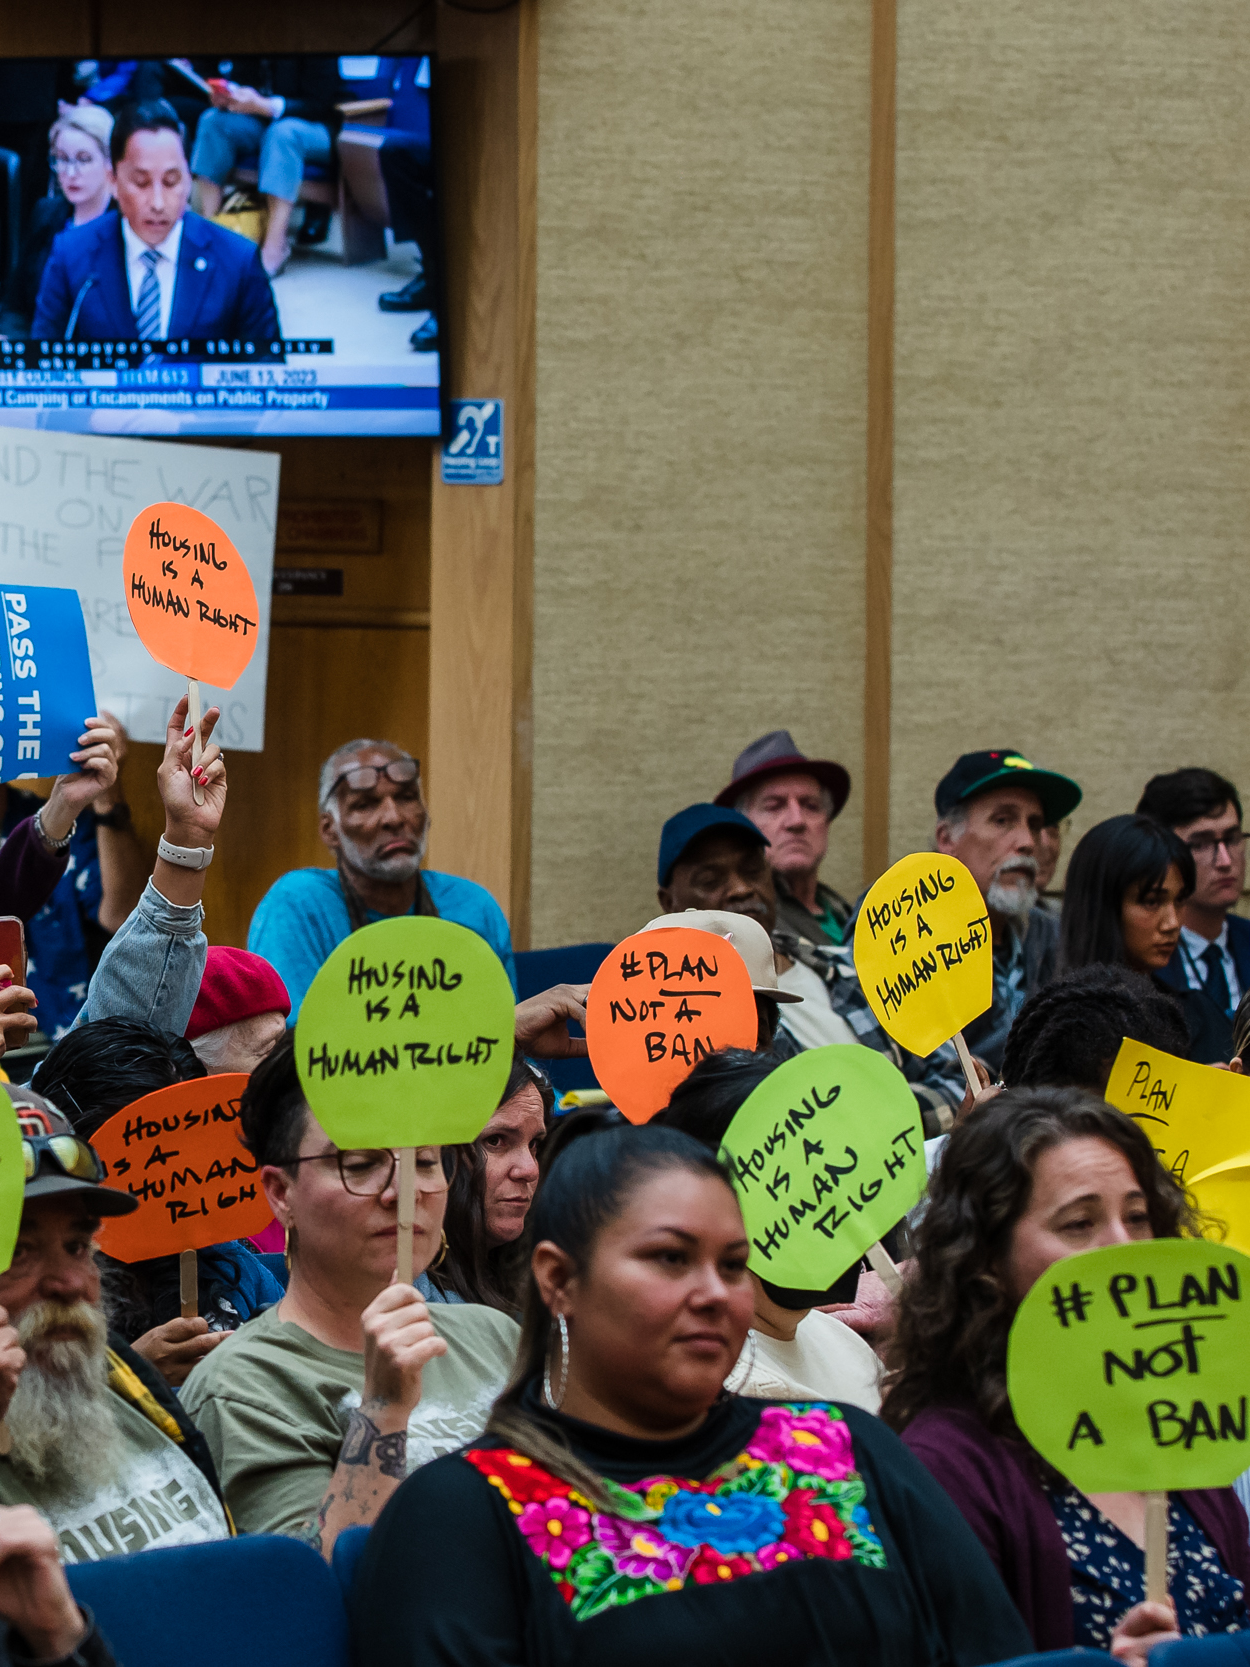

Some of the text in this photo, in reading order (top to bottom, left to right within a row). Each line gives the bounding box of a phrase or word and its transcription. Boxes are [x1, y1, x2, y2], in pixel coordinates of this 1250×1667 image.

[39, 340, 153, 357] taxpayers
[166, 339, 190, 354] of
[206, 339, 256, 354] this
[269, 340, 321, 356] city
[5, 389, 69, 410] Camping
[72, 392, 87, 404] or
[90, 389, 193, 408] Encampments
[195, 392, 215, 406] on
[217, 390, 264, 406] Public
[265, 390, 330, 409] Property
[216, 369, 251, 386] JUNE
[282, 369, 319, 386] 2023
[52, 449, 143, 500] THE
[157, 464, 273, 535] WAR
[54, 497, 124, 534] ON
[149, 518, 228, 571] HOUSING
[161, 560, 205, 590] IS A
[131, 573, 257, 636] HUMAN RIGHT
[1, 591, 38, 682] PASS
[17, 690, 42, 760] THE
[866, 868, 955, 940] HOUSING
[890, 913, 933, 956] IS A
[876, 915, 990, 1021] HUMAN RIGHT
[365, 991, 420, 1023] IS A
[609, 997, 702, 1025] NOT A
[308, 1036, 500, 1081] HUMAN RIGHT
[644, 1031, 716, 1067] BAN
[1126, 1061, 1178, 1112] PLAN
[122, 1098, 243, 1147] HOUSIN
[736, 1085, 841, 1194] HOUSING
[101, 1144, 180, 1179] IS A
[128, 1156, 258, 1202] HUMAN
[765, 1138, 825, 1202] IS A
[812, 1125, 918, 1240] RIGHT
[1169, 1149, 1190, 1184] A
[165, 1183, 258, 1225] RIGH
[752, 1145, 859, 1262] HUMAN
[1067, 1395, 1248, 1451] A BAN
